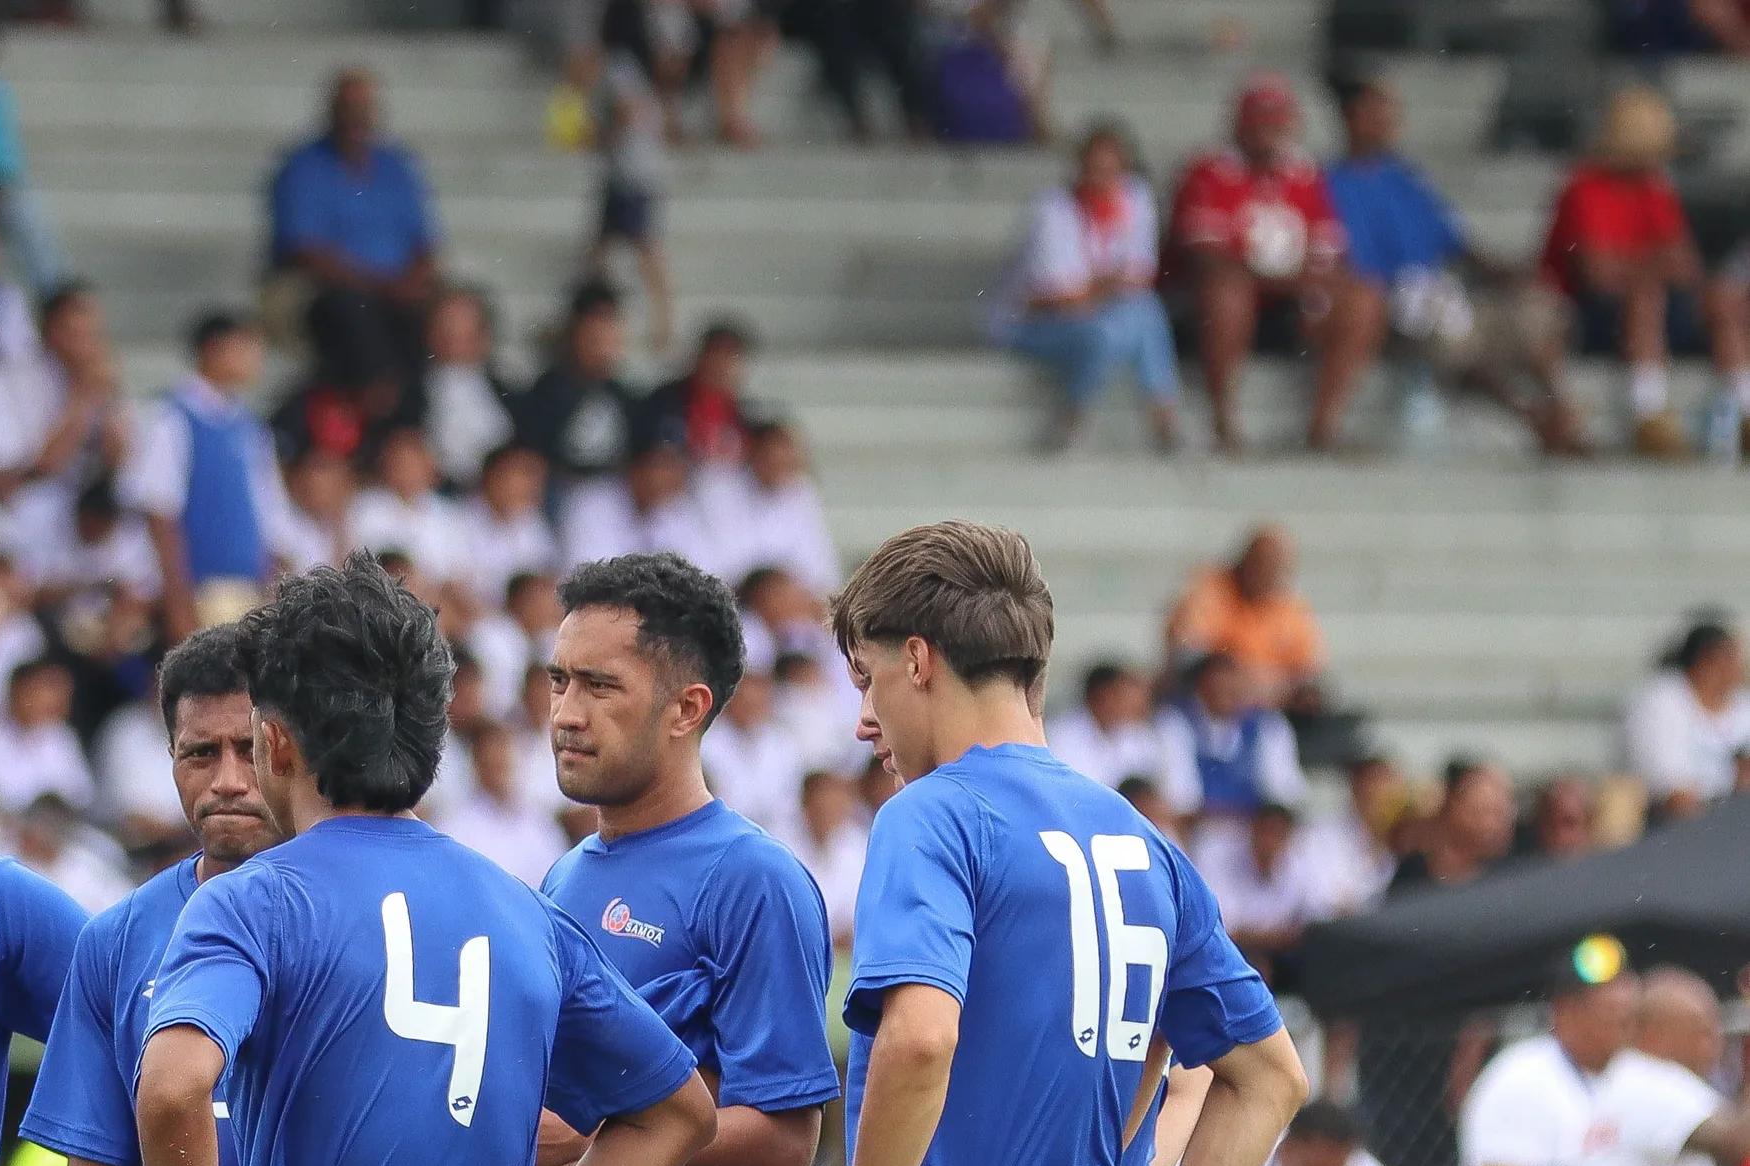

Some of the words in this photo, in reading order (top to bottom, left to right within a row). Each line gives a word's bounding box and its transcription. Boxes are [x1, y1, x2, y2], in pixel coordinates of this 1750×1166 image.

[381, 891, 490, 1128] 4
[624, 921, 663, 943] SAMOA
[1038, 830, 1168, 1062] 16
